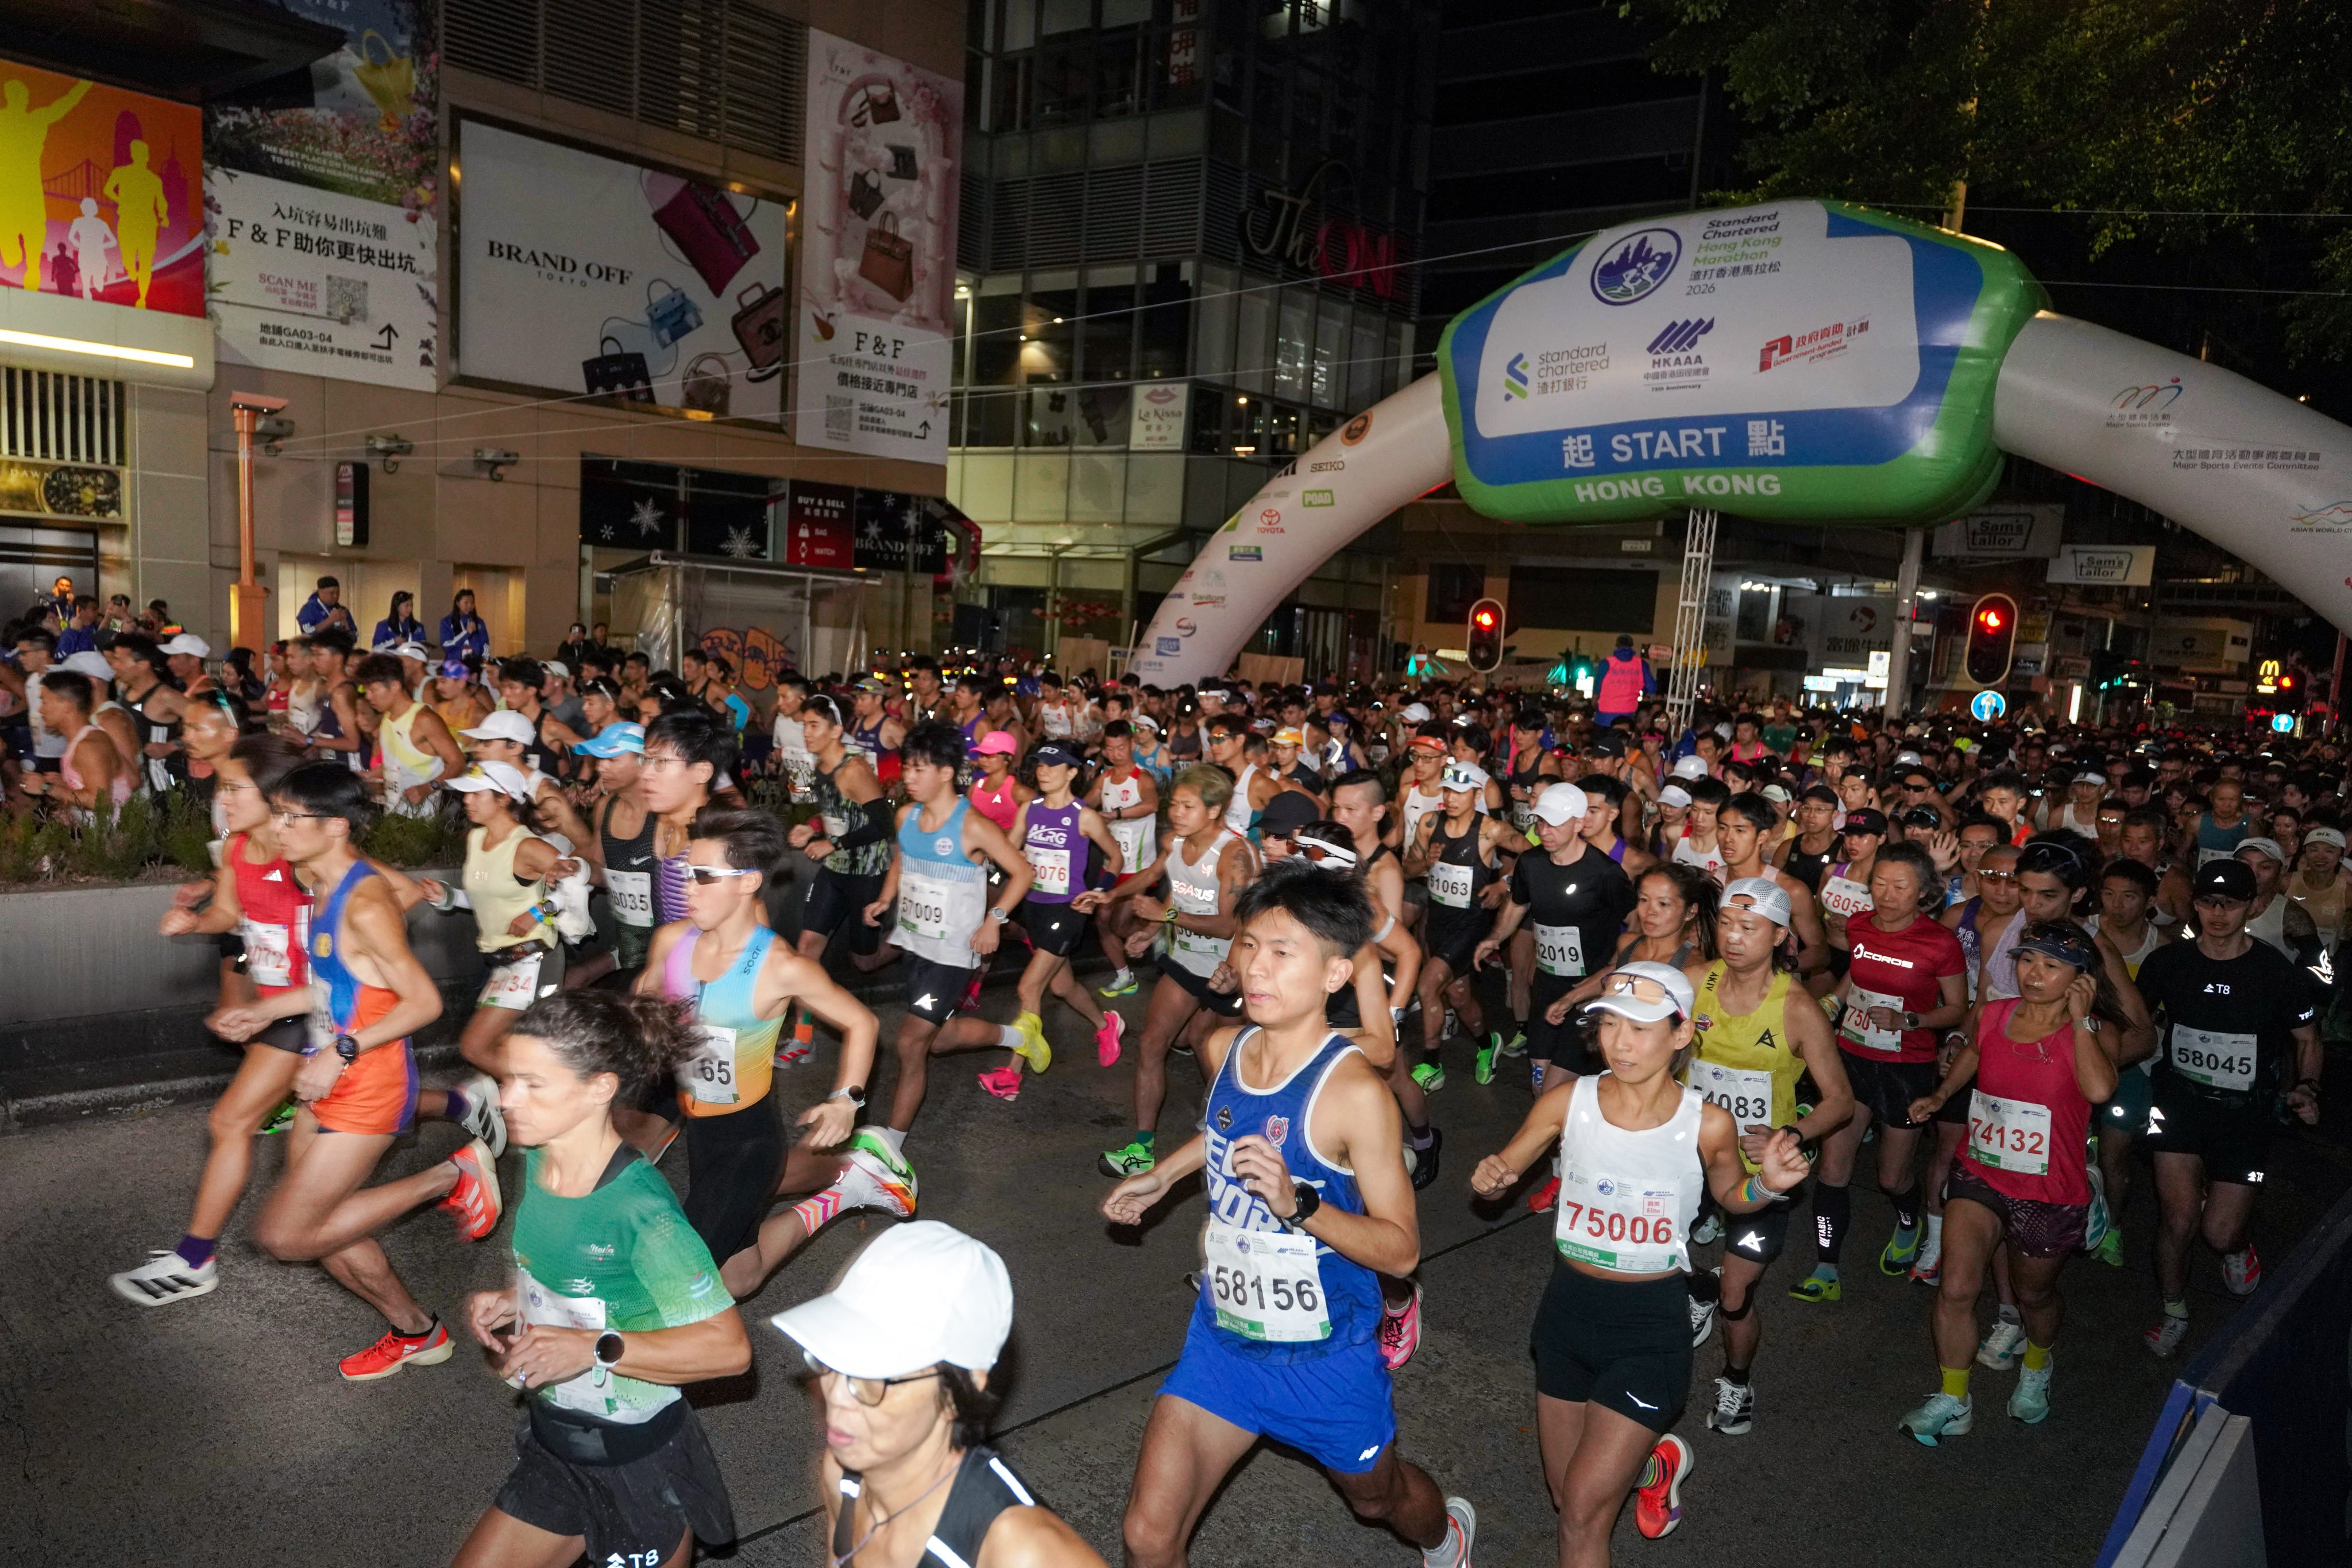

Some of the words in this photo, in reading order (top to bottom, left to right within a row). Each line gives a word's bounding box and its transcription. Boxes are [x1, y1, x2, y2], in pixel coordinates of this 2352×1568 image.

[1707, 211, 1778, 229] Standard
[250, 223, 268, 245] &
[1702, 222, 1780, 240] Chartered
[1697, 241, 1737, 253] Hong
[1741, 235, 1783, 248] Kong
[488, 240, 577, 273] BRAND
[585, 262, 633, 285] OFF
[1693, 250, 1768, 267] Marathon
[538, 270, 587, 287] TOKYO
[1689, 260, 1781, 282] 渣打香港馬拉松
[258, 272, 293, 288] SCAN
[297, 280, 317, 292] ME
[1686, 283, 1716, 296] 2026
[855, 331, 868, 352] F
[872, 335, 887, 357] &
[891, 339, 905, 359] F
[1539, 341, 1607, 365] standard
[1538, 355, 1609, 379] chartered
[1652, 354, 1703, 369] HKAAA
[1538, 376, 1588, 395] 渣打銀行
[1562, 434, 1595, 469] 起
[1611, 426, 1727, 463] START
[1747, 419, 1785, 457] 點
[1310, 460, 1345, 473] SEIKO
[2173, 462, 2196, 470] Major
[2200, 462, 2230, 471] Sports
[2266, 462, 2320, 471] Committee
[1574, 477, 1666, 503] HONG
[1682, 473, 1781, 497] KONG
[797, 496, 815, 505] BUY
[817, 498, 823, 506] &
[825, 499, 846, 509] SELL
[1980, 519, 2023, 533] Sam's
[855, 537, 905, 553] BRAND
[2086, 555, 2124, 566] Sam's
[2079, 563, 2115, 577] tailor
[481, 871, 488, 881] T8
[902, 897, 943, 924] 57009
[743, 945, 762, 975] soar
[1863, 951, 1914, 969] COROS
[1705, 971, 1719, 992] AKIV
[2215, 983, 2230, 995] T8
[2177, 1046, 2251, 1075] 58045
[1971, 1117, 2044, 1156] 74132
[1566, 1199, 1673, 1245] 75006
[1592, 1257, 1615, 1266] Challenge
[1215, 1264, 1318, 1312] 58156
[1244, 1328, 1265, 1338] Challenge
[628, 1549, 659, 1568] T8
